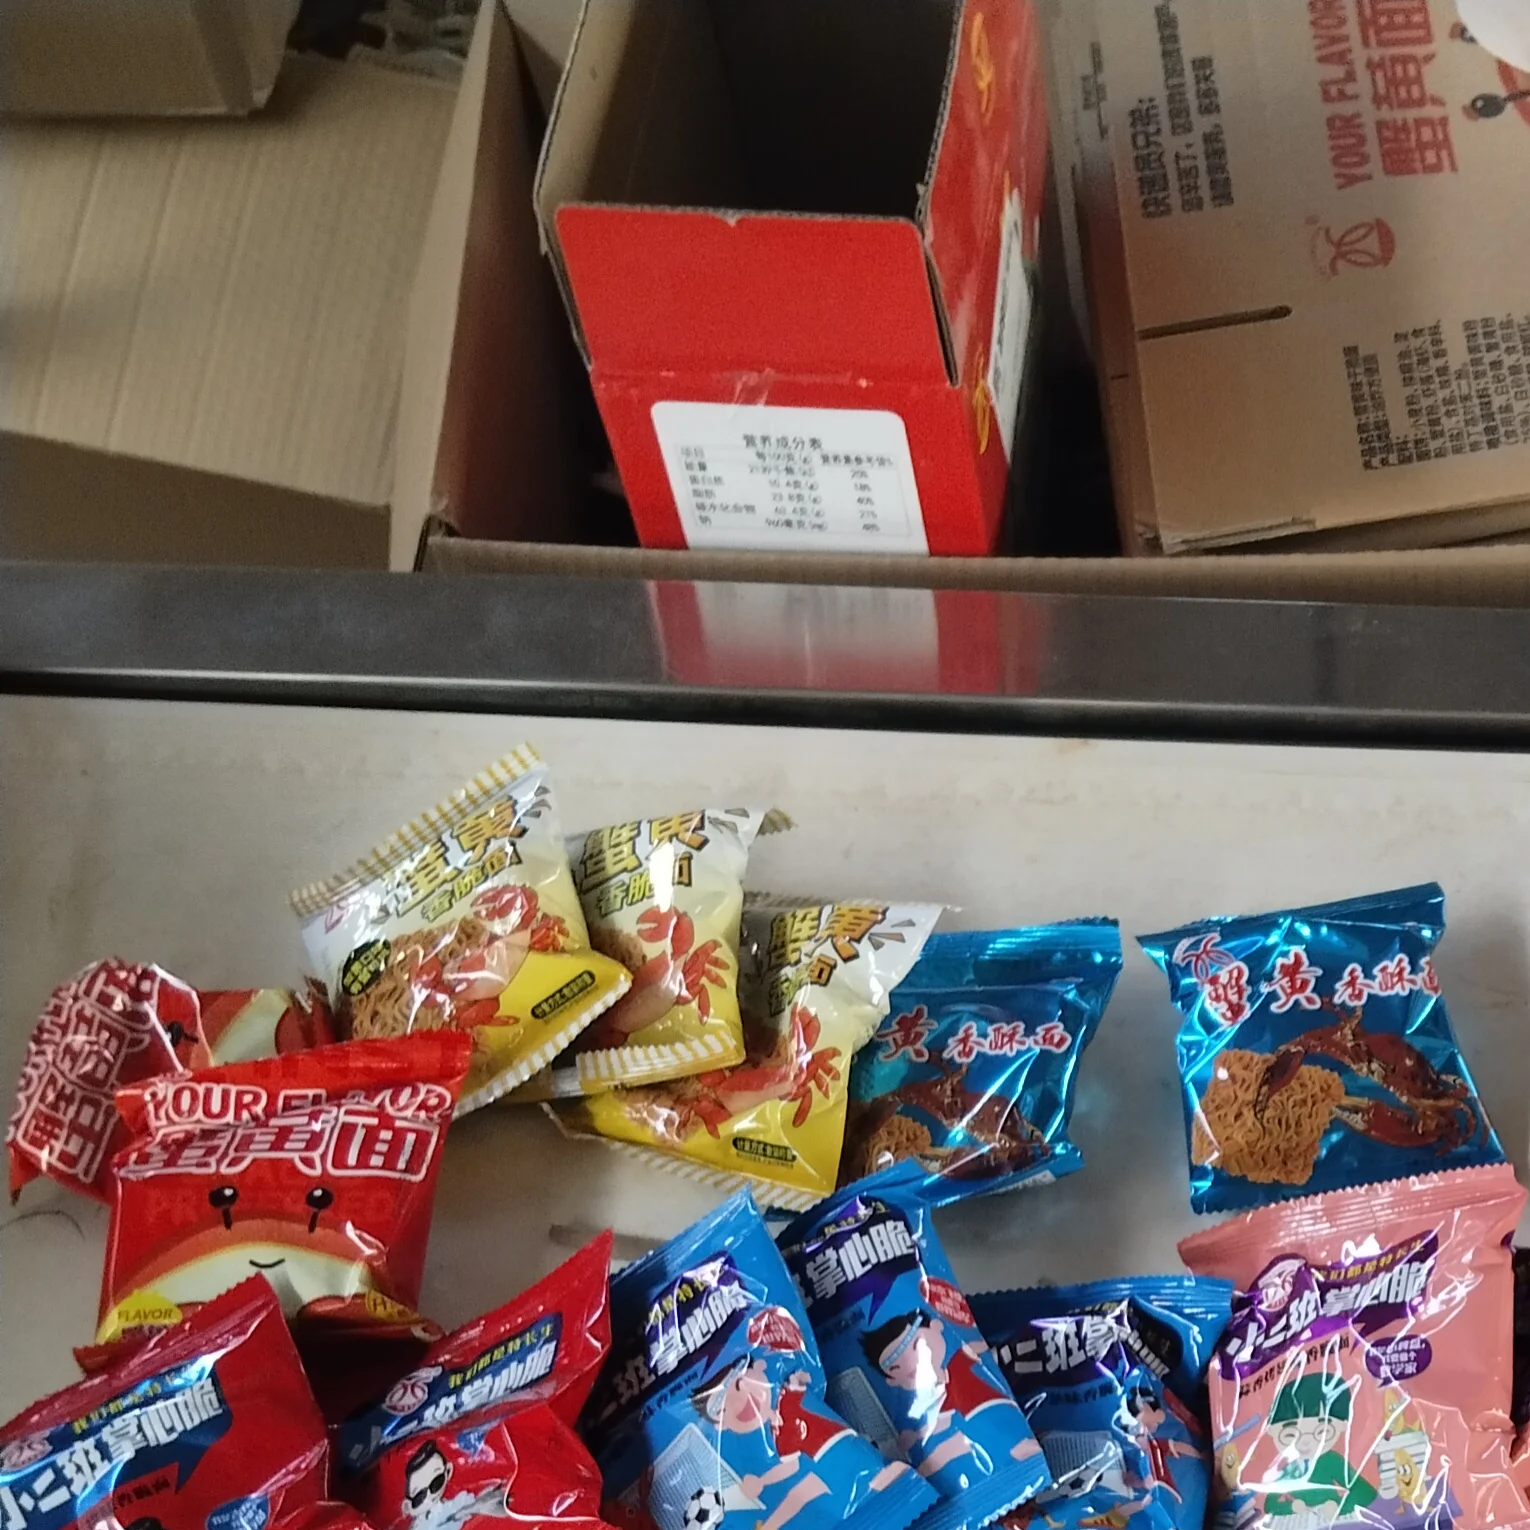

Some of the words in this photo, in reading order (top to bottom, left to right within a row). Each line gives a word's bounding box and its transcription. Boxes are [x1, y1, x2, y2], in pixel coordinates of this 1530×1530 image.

[1328, 112, 1372, 191] YOUR
[579, 811, 710, 892] 蟹黄
[768, 905, 889, 971] 蟹黄
